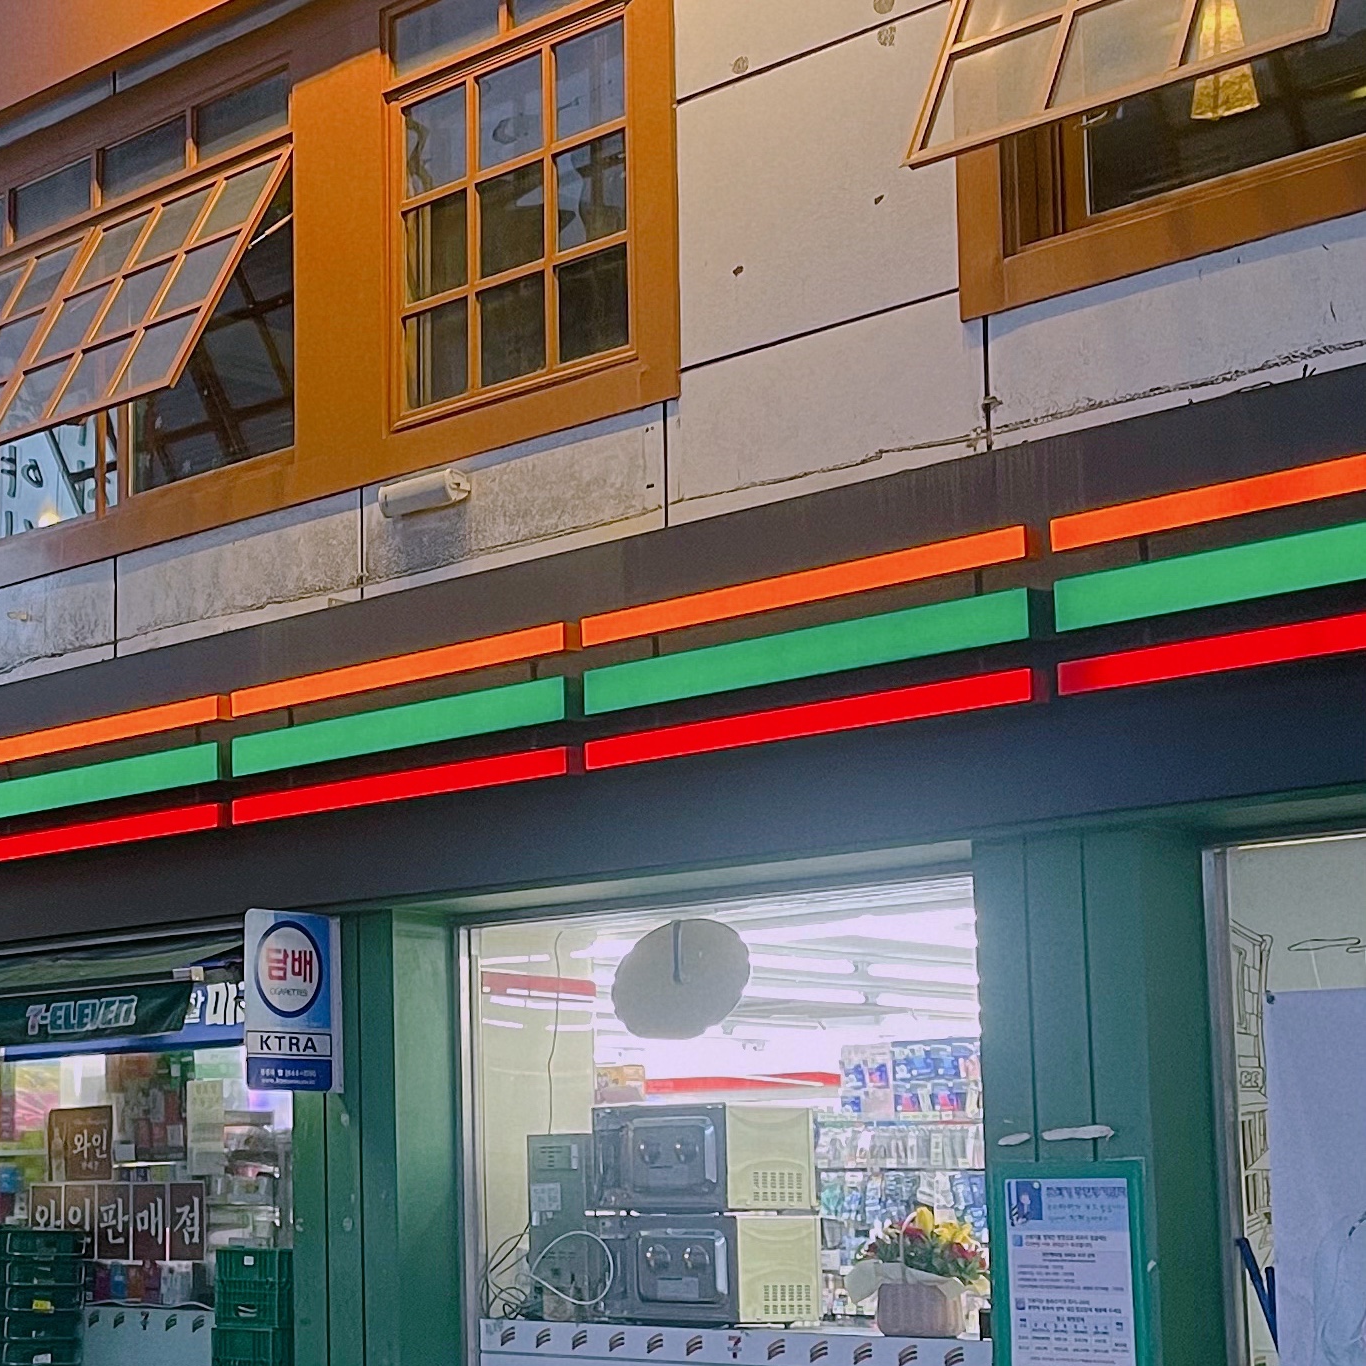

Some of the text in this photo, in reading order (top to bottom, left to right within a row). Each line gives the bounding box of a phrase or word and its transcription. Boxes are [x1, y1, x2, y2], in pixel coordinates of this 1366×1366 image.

[266, 948, 314, 984] 담배
[259, 1034, 317, 1053] KTRA
[72, 1128, 109, 1160] 와인
